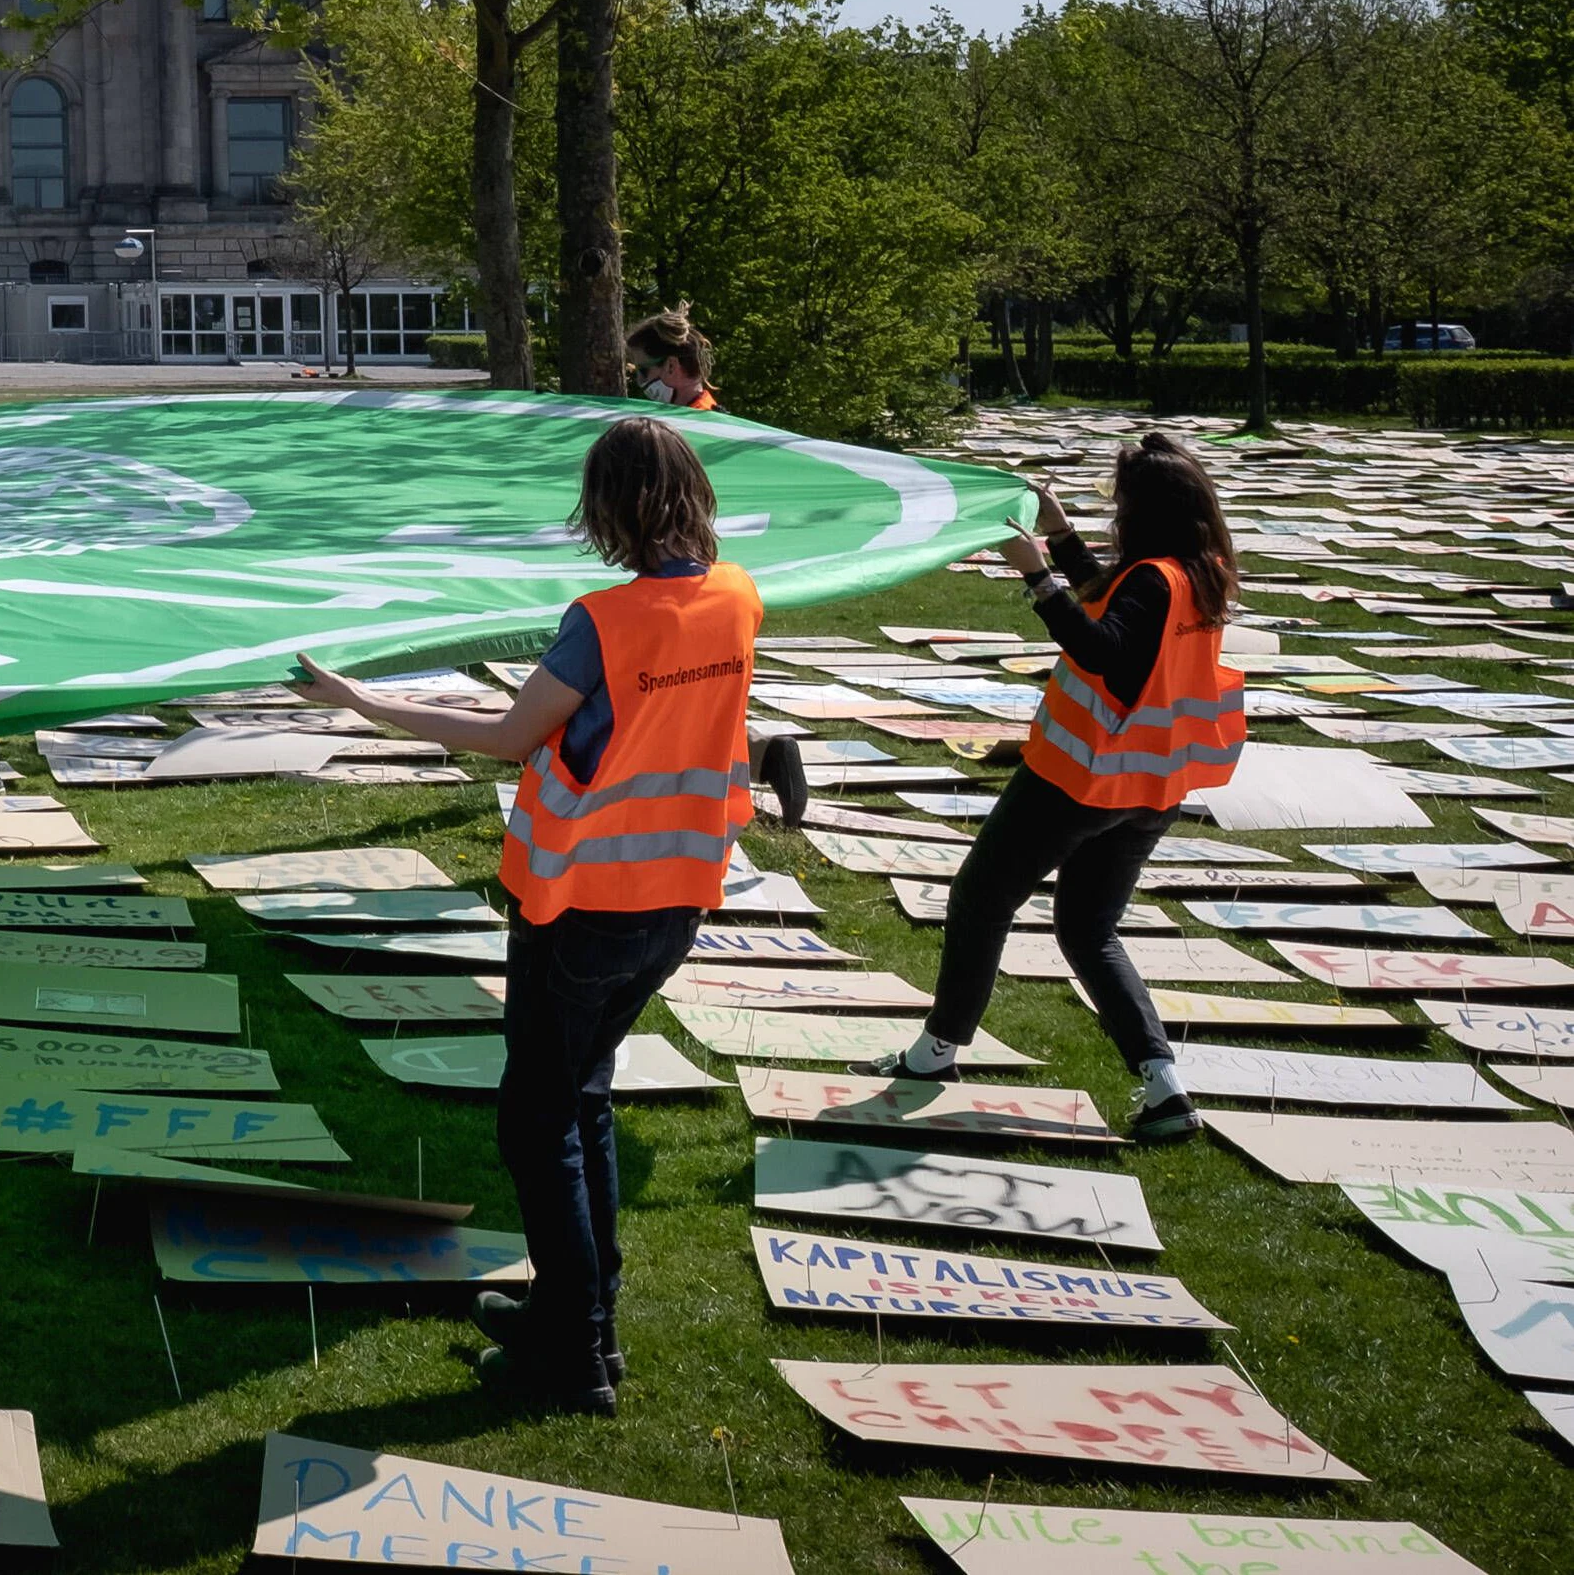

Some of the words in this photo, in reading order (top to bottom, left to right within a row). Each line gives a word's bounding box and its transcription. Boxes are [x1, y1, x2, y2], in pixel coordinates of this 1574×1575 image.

[766, 1237, 1173, 1301] KAPITALISMUS
[781, 1287, 1205, 1326] NATURGESETZ
[867, 1278, 962, 1299] IST
[981, 1290, 1101, 1308] KEIN
[826, 1378, 1014, 1411] LET
[1085, 1383, 1247, 1419] MY
[846, 1410, 1317, 1456] CHILDREN
[993, 1437, 1259, 1473] LIVE
[282, 1458, 609, 1543] DANKE
[913, 1508, 1124, 1548] unite
[1186, 1516, 1446, 1556] behind
